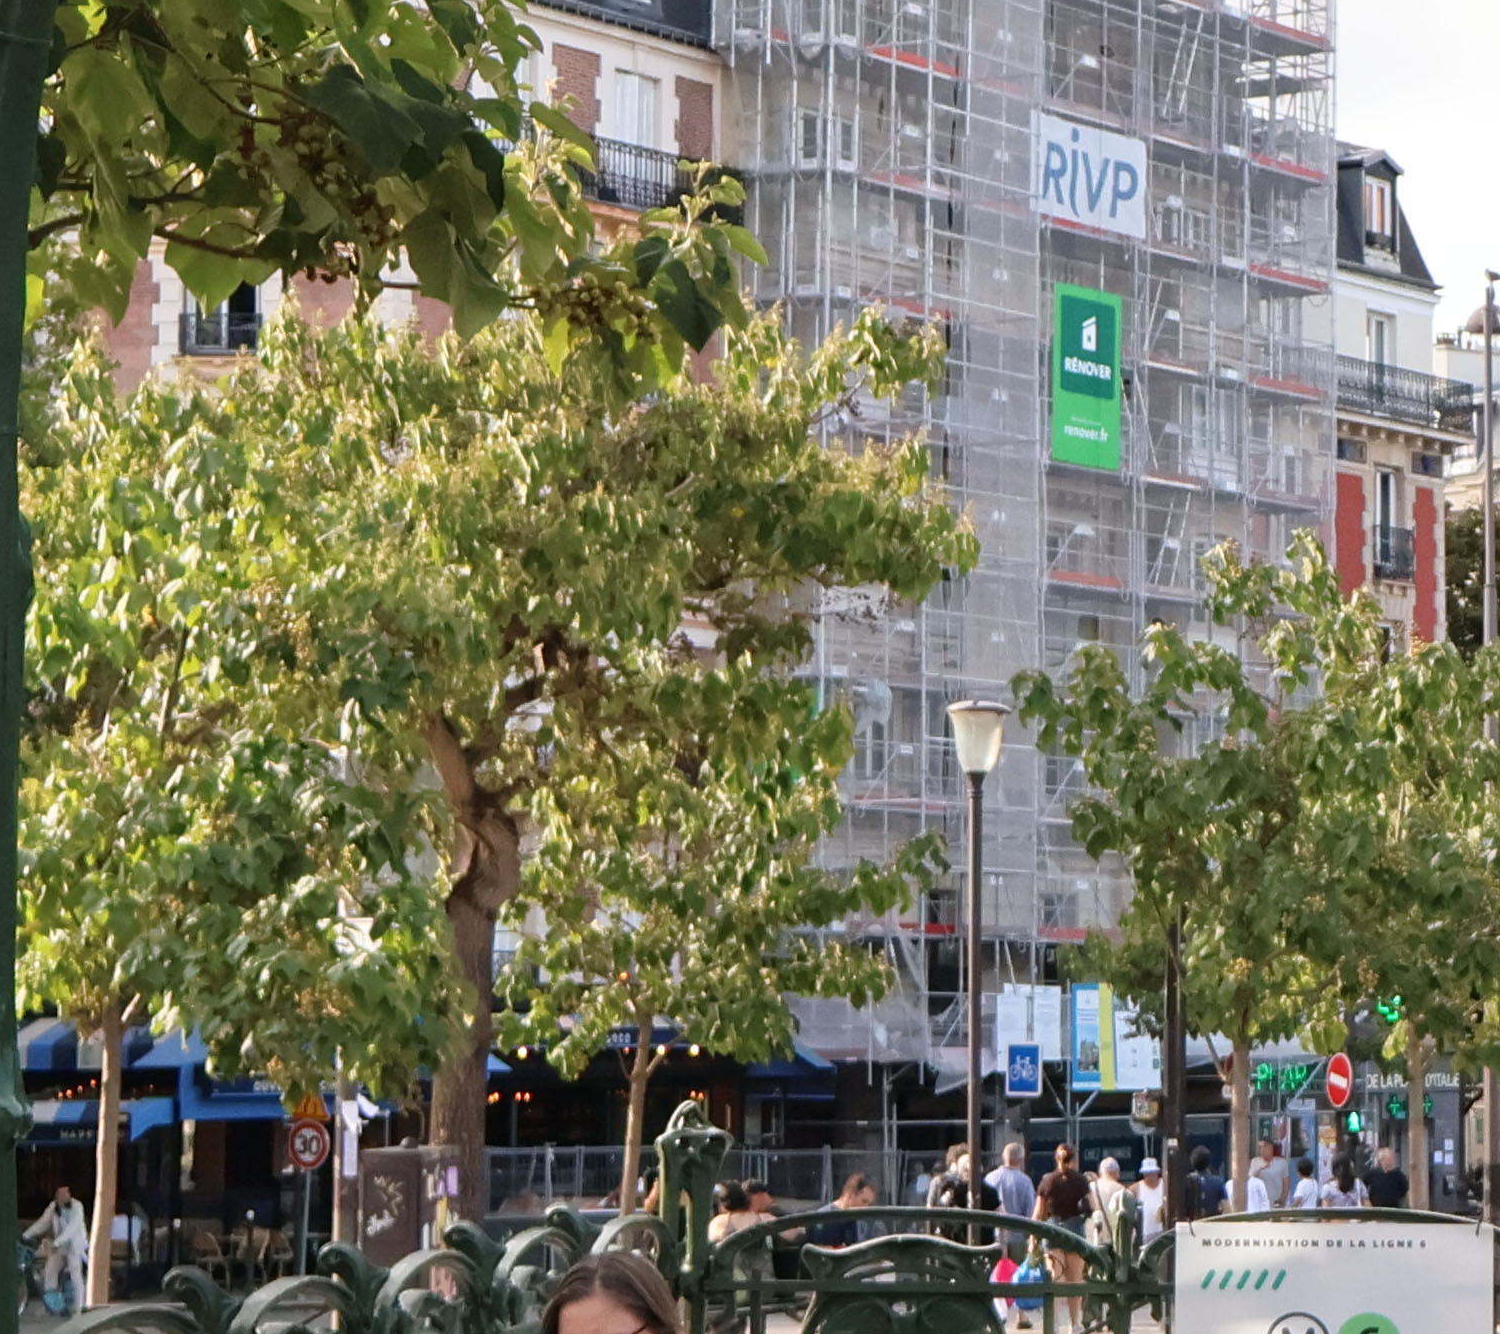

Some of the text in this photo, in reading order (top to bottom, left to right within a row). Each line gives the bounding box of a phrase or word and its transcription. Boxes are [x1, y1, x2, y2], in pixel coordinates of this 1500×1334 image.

[1064, 356, 1112, 380] RÉNOVER
[1366, 1073, 1379, 1088] DE
[1380, 1072, 1393, 1088] LA
[299, 1133, 321, 1155] 30
[1201, 1238, 1428, 1249] MODERNISATION DE LA LIGNE 6
